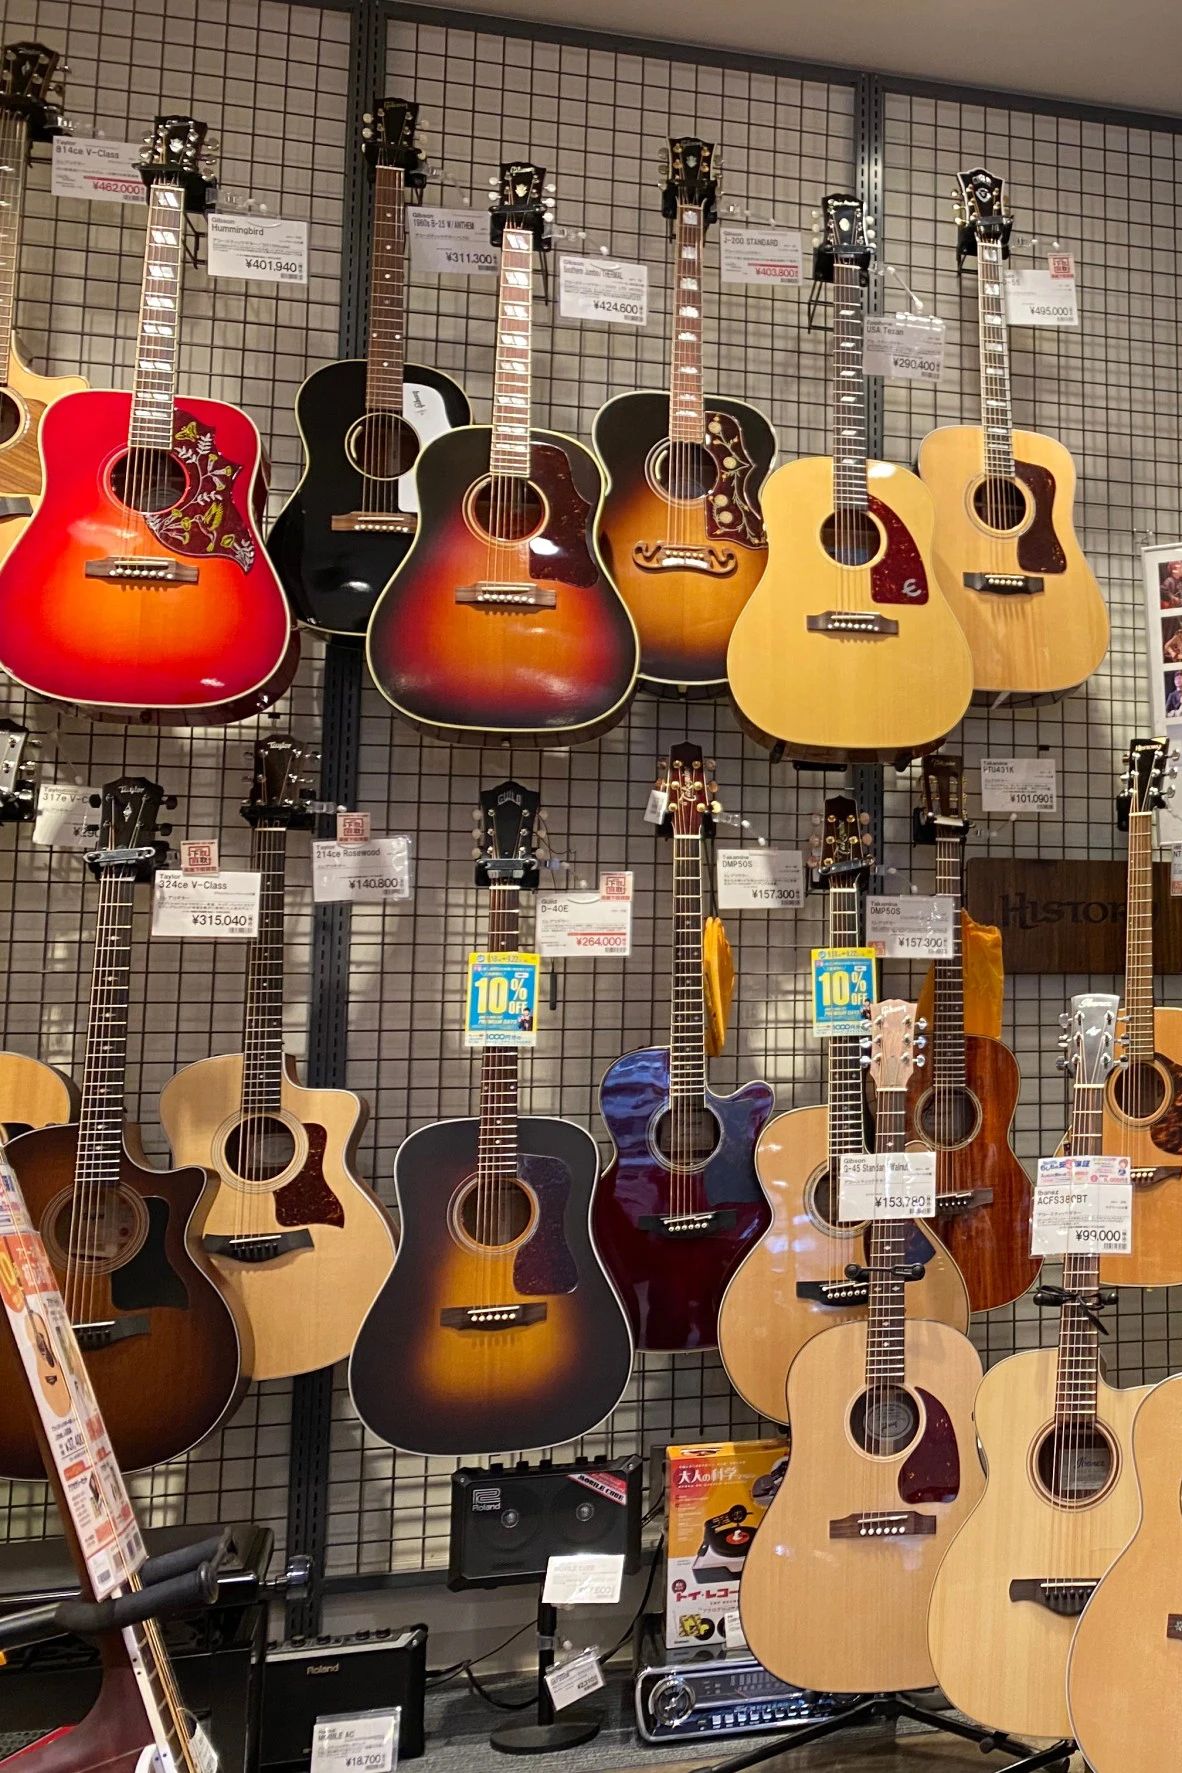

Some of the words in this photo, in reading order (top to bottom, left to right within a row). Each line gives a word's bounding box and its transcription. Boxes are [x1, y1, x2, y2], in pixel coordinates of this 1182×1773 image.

[56, 145, 84, 155] 814ce
[86, 148, 119, 159] V-Class
[212, 223, 264, 236] Hummingbird
[866, 326, 880, 335] USA
[884, 327, 904, 336] Texan
[316, 850, 341, 859] 214ce
[343, 849, 381, 857] Rosewood
[722, 860, 753, 868] DMP50S
[159, 880, 188, 889] 324ce
[191, 880, 227, 890] V-Class
[541, 904, 569, 913] D-40E
[870, 906, 901, 915] DMP50S
[474, 976, 528, 1014] 10%
[508, 1001, 528, 1014] OFF
[679, 1466, 737, 1485] 大人の科学
[577, 1474, 604, 1492] MOBILE
[472, 1503, 501, 1512] Roland
[676, 1587, 740, 1602] トイ・レコー
[307, 1663, 340, 1675] Roland
